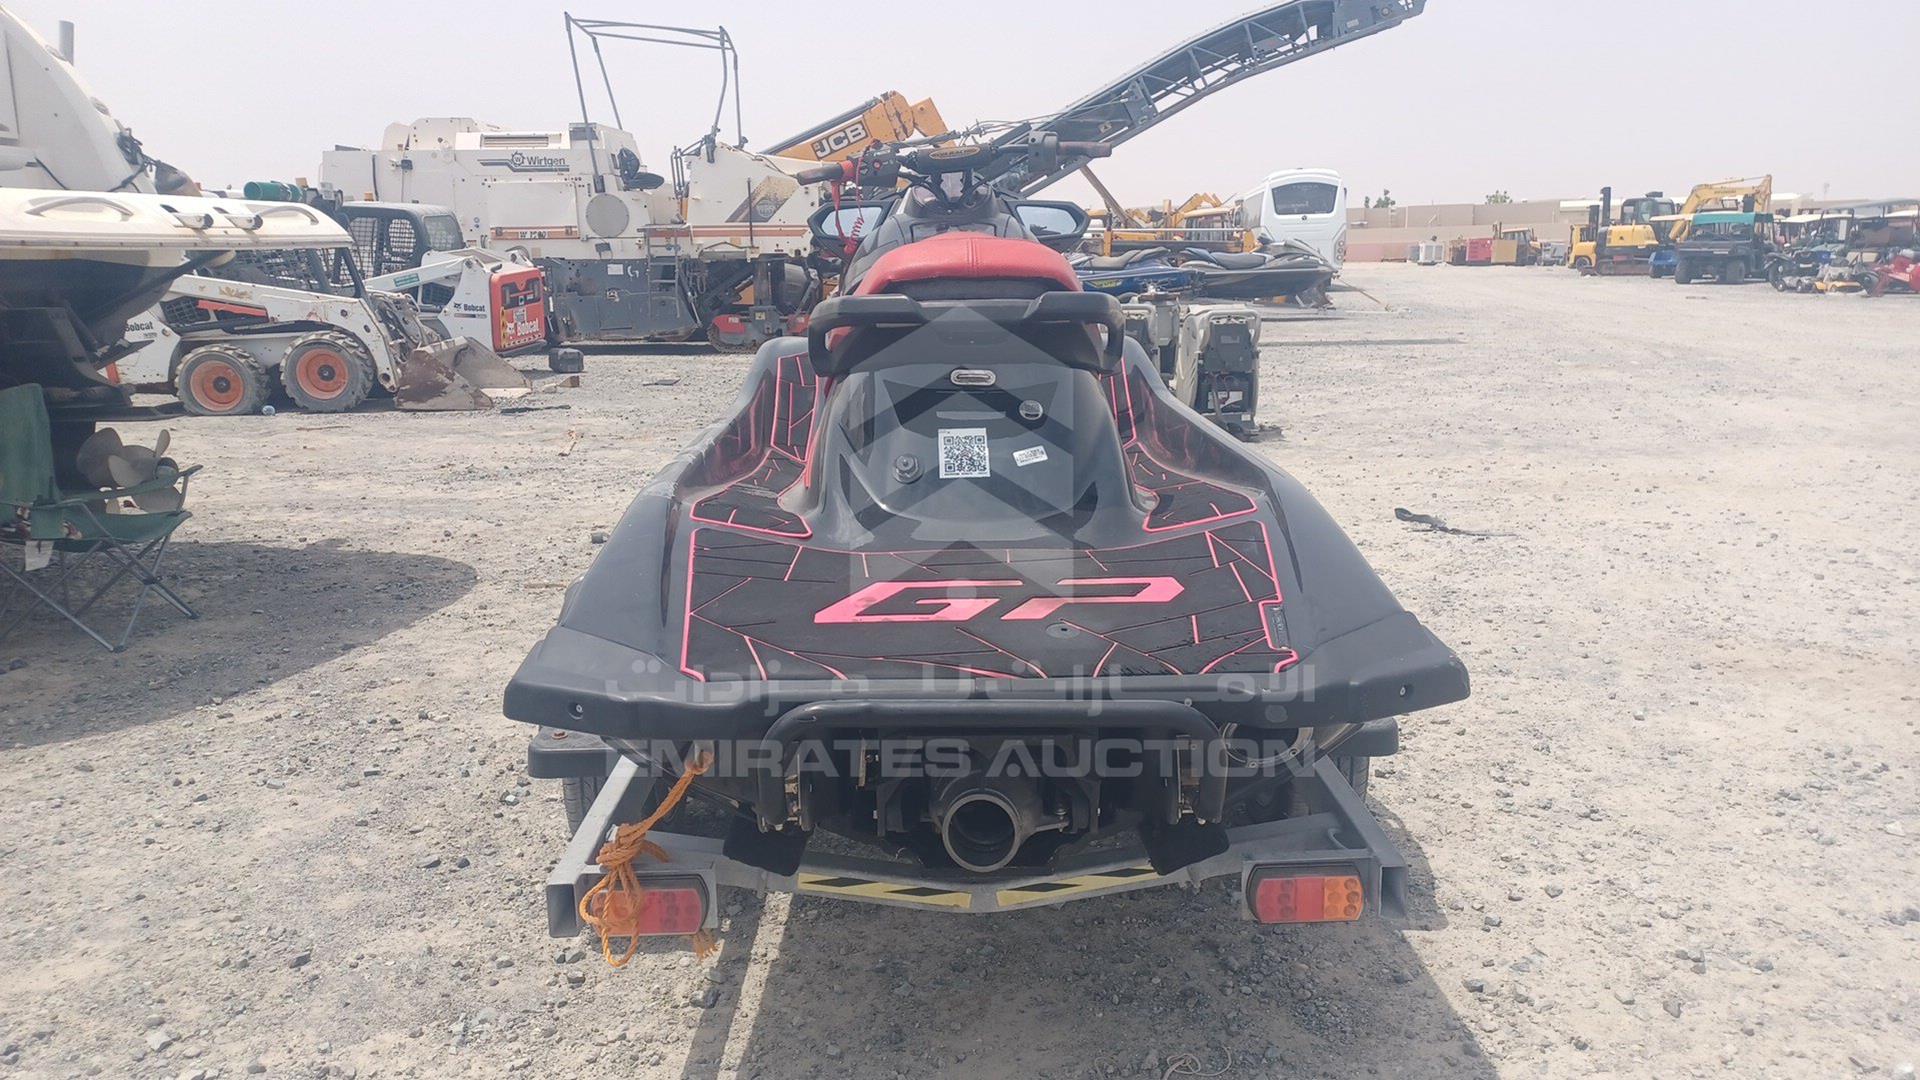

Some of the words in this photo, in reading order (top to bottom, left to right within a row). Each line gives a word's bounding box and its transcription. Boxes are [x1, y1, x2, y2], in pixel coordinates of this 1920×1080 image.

[813, 122, 867, 157] JCB
[527, 156, 566, 166] Wirtgen
[464, 303, 485, 312] Bobcat
[517, 318, 539, 335] Bobcat
[814, 576, 1185, 623] GP
